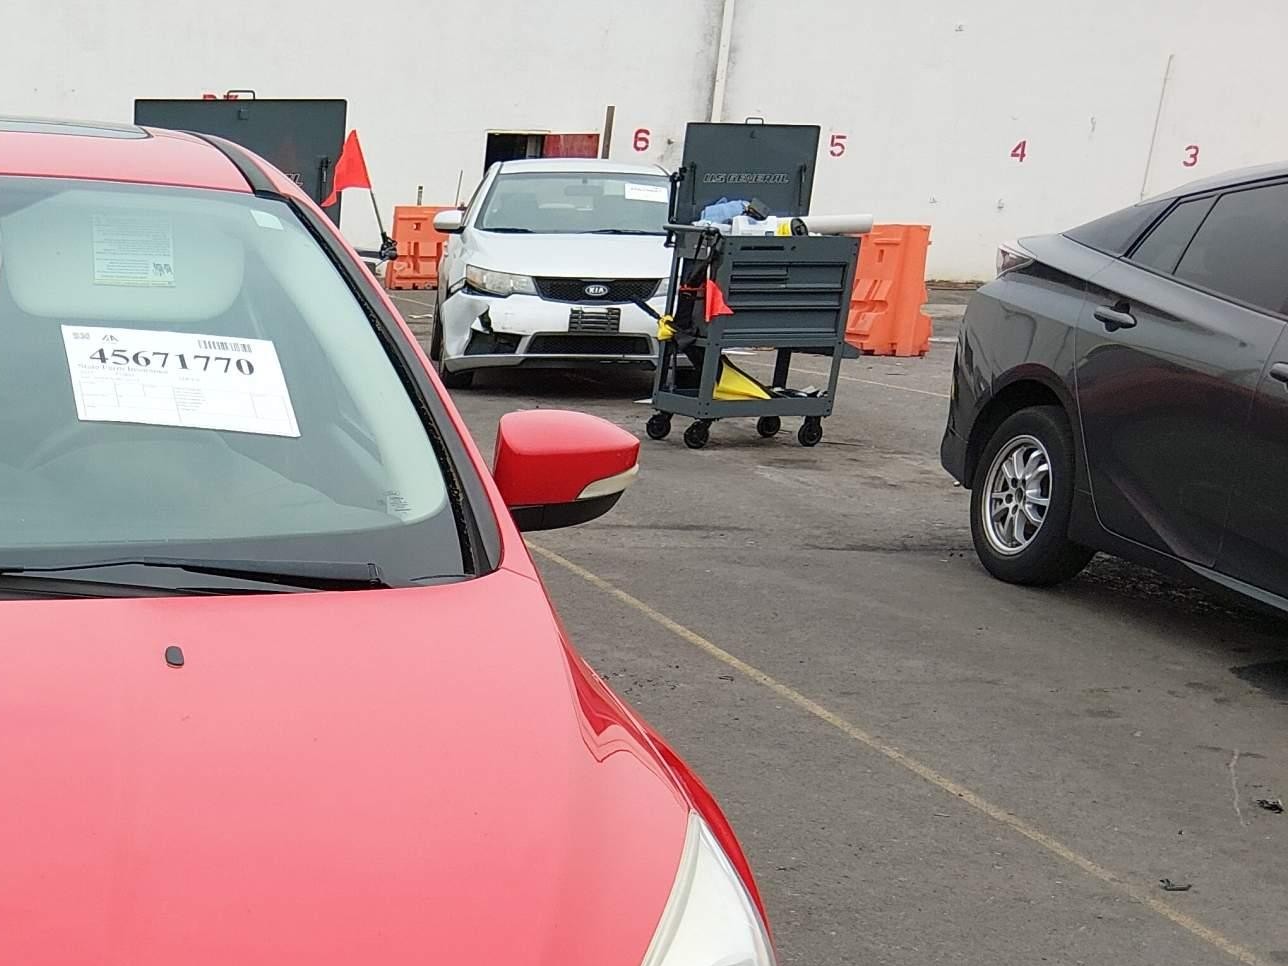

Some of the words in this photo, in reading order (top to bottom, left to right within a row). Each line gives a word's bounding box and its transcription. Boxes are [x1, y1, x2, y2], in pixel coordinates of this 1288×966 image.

[632, 128, 651, 151] 6
[829, 134, 848, 157] 5
[1010, 140, 1028, 162] 4
[1182, 144, 1201, 167] 3
[588, 286, 605, 294] KIA
[89, 347, 254, 376] 45671770
